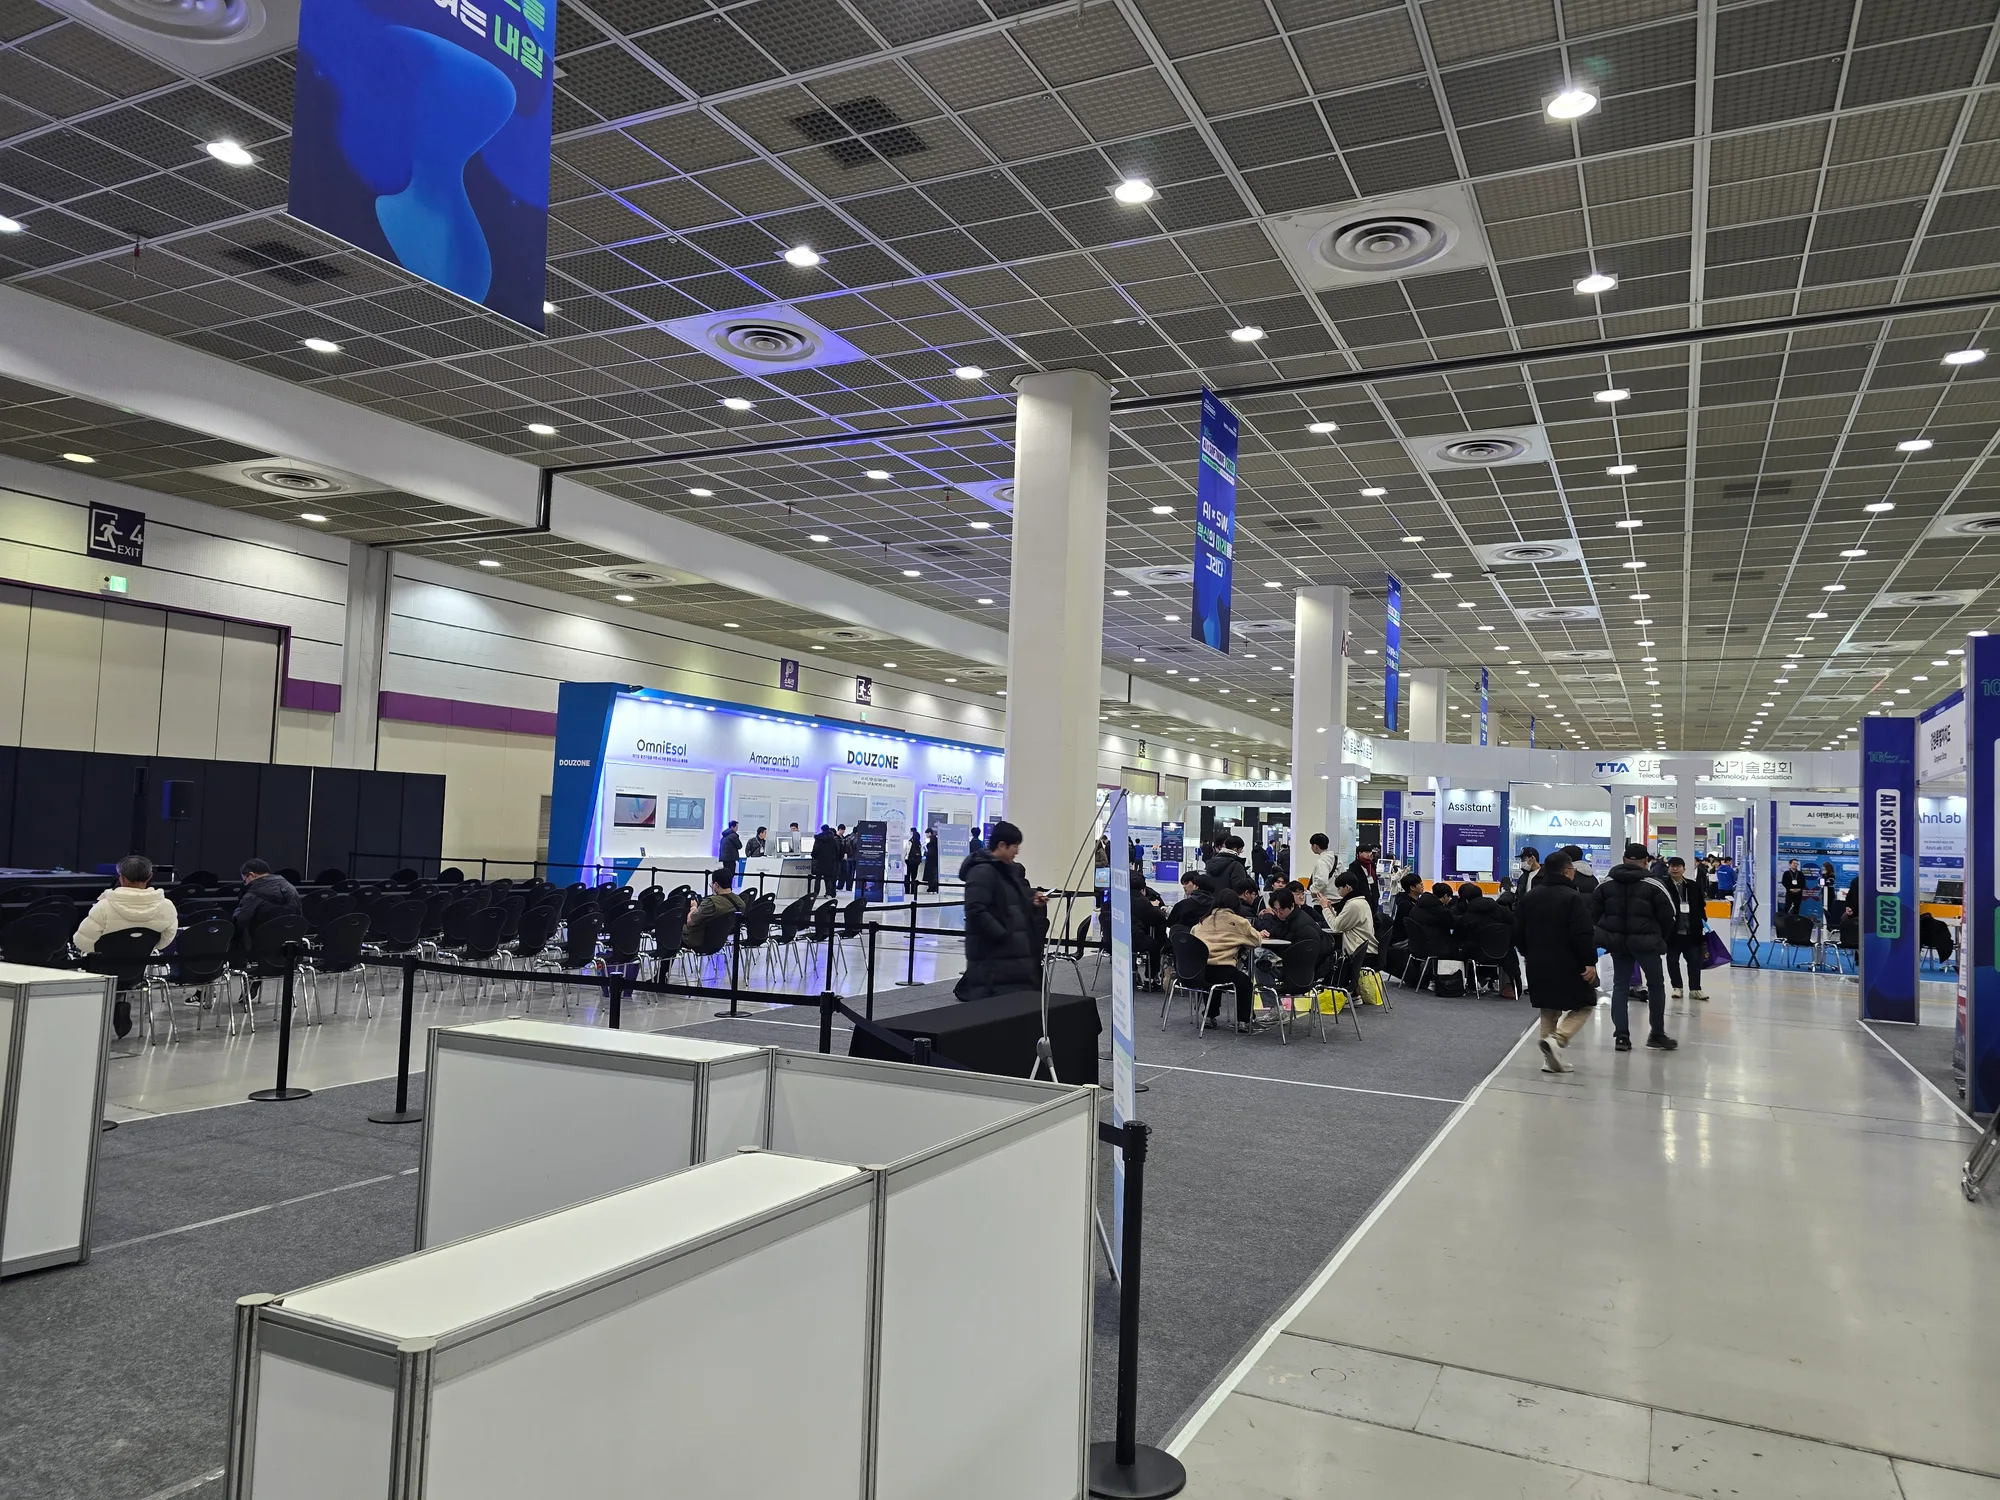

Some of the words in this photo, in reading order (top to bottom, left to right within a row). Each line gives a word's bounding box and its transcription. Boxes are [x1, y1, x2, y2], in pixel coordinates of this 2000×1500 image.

[494, 14, 544, 79] 내일
[1203, 501, 1211, 520] AI
[130, 525, 143, 545] 4
[117, 544, 141, 558] EXIT
[637, 739, 687, 756] OmniEsol
[559, 759, 591, 767] DOUZONE
[749, 751, 790, 767] Amaranth
[791, 756, 799, 768] 10
[847, 750, 899, 769] DOUZONE
[1594, 763, 1629, 772] TTA
[937, 774, 962, 785] WEHAGO
[1448, 802, 1492, 812] Assistant
[1880, 794, 1896, 806] AI
[1564, 818, 1590, 827] Nexa
[1592, 819, 1603, 827] AI
[1880, 820, 1897, 888] SOFTWAVE
[1880, 900, 1897, 934] 2025
